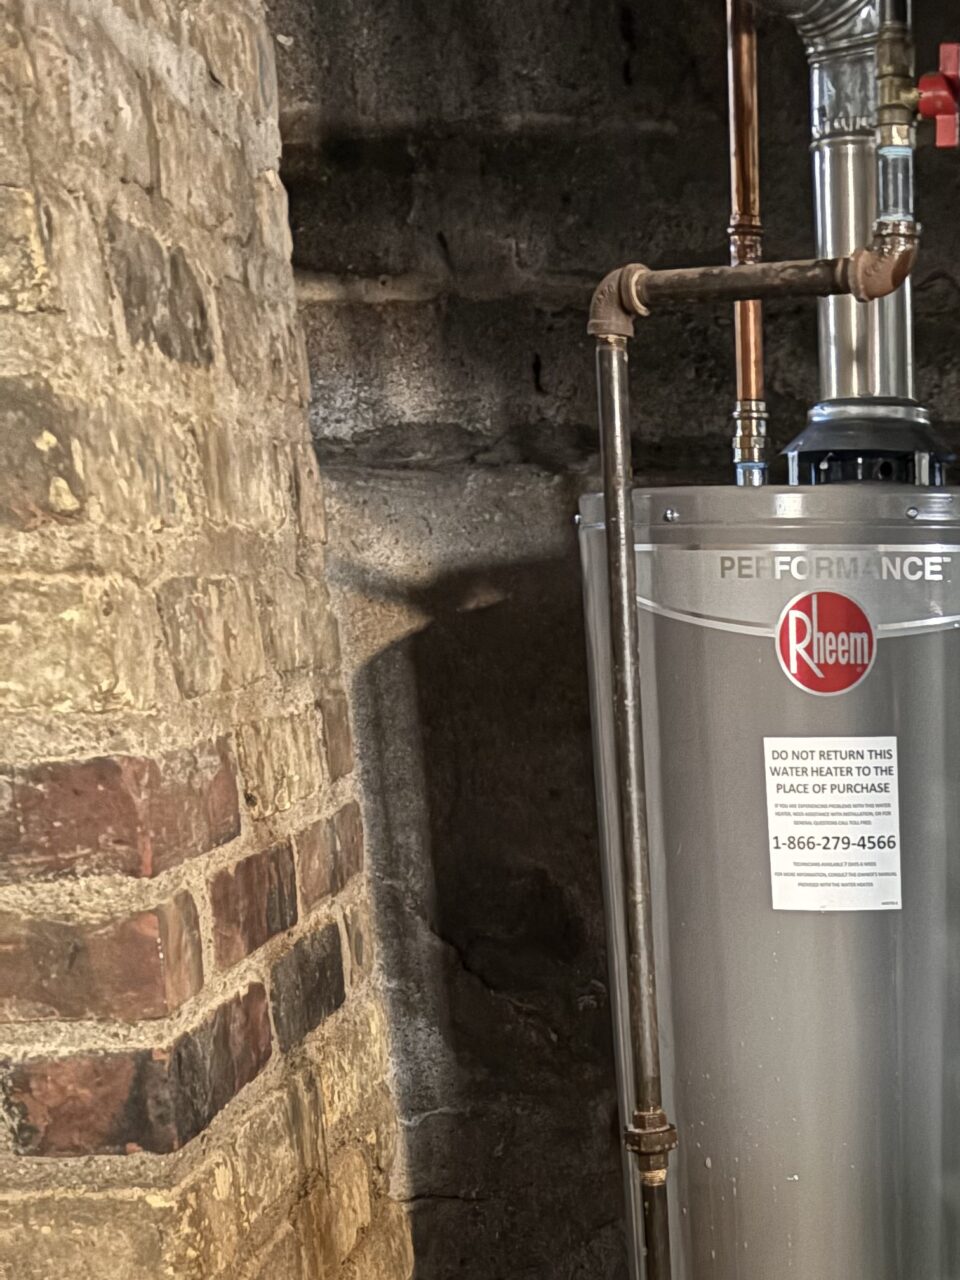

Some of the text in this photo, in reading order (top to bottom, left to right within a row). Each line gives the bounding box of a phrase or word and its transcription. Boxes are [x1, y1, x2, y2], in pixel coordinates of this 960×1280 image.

[788, 594, 869, 678] Rheem
[771, 749, 893, 760] DO NOT RETURN THIS
[769, 766, 894, 776] WATER HEATER TO THE
[776, 783, 890, 794] PLACE OF PURCHASE
[772, 835, 896, 850] 1-866-279-4566
